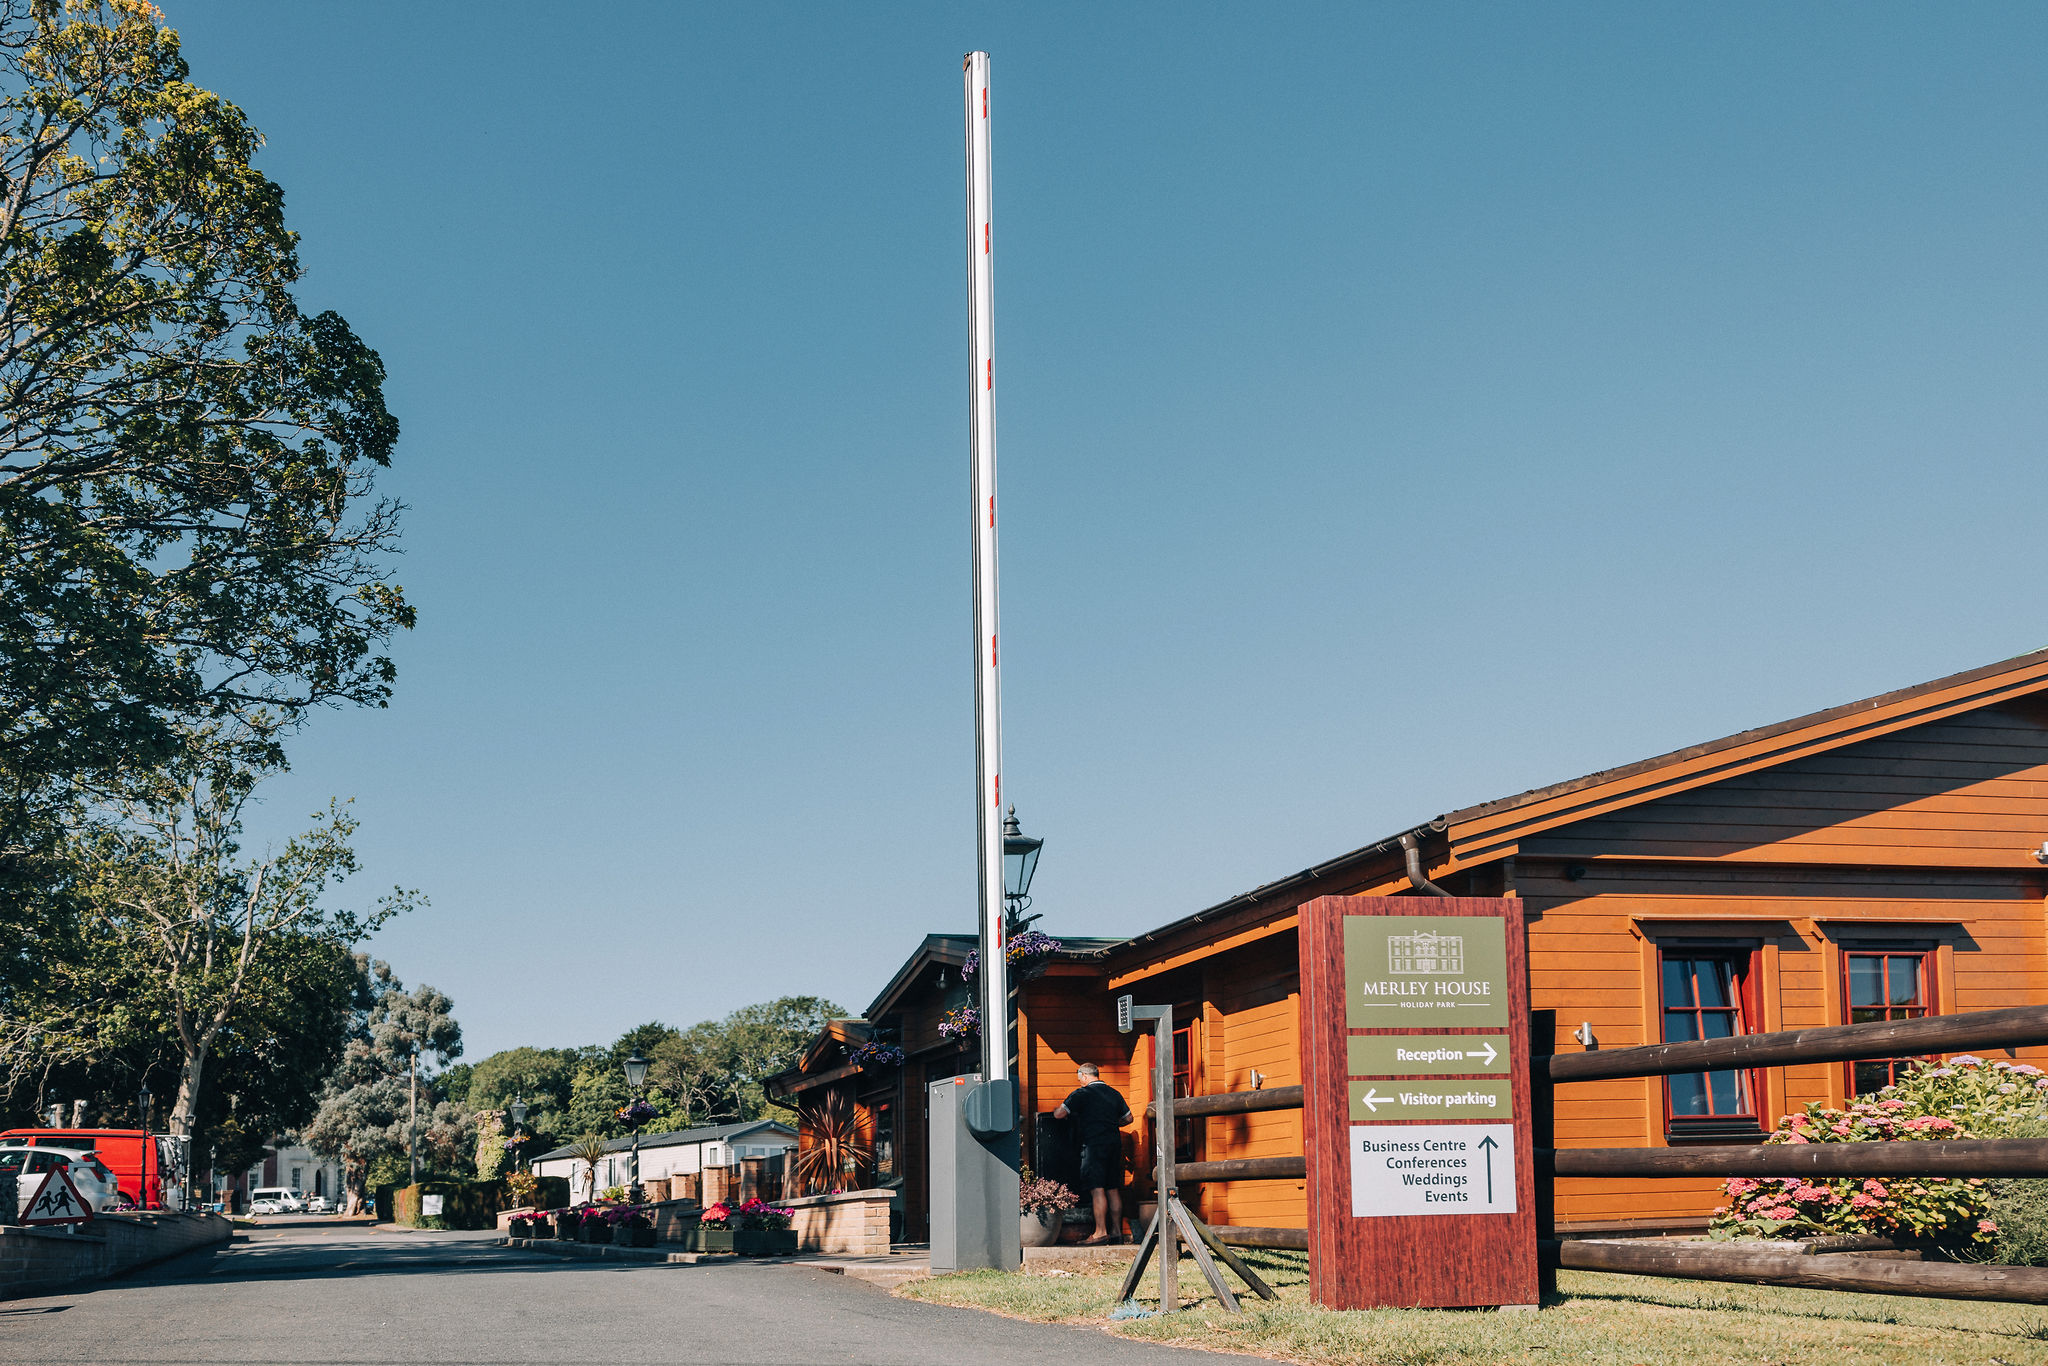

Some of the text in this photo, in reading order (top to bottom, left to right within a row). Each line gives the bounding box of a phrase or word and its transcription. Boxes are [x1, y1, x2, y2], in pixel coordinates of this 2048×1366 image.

[1364, 981, 1490, 995] MERLEY HOUSE
[1397, 1048, 1463, 1063] Reception
[1399, 1092, 1496, 1107] Visitor parking
[1363, 1139, 1466, 1152] Business Centre
[1386, 1156, 1467, 1168] Conferences
[1402, 1173, 1467, 1187] Weddings
[1425, 1190, 1468, 1202] Events
